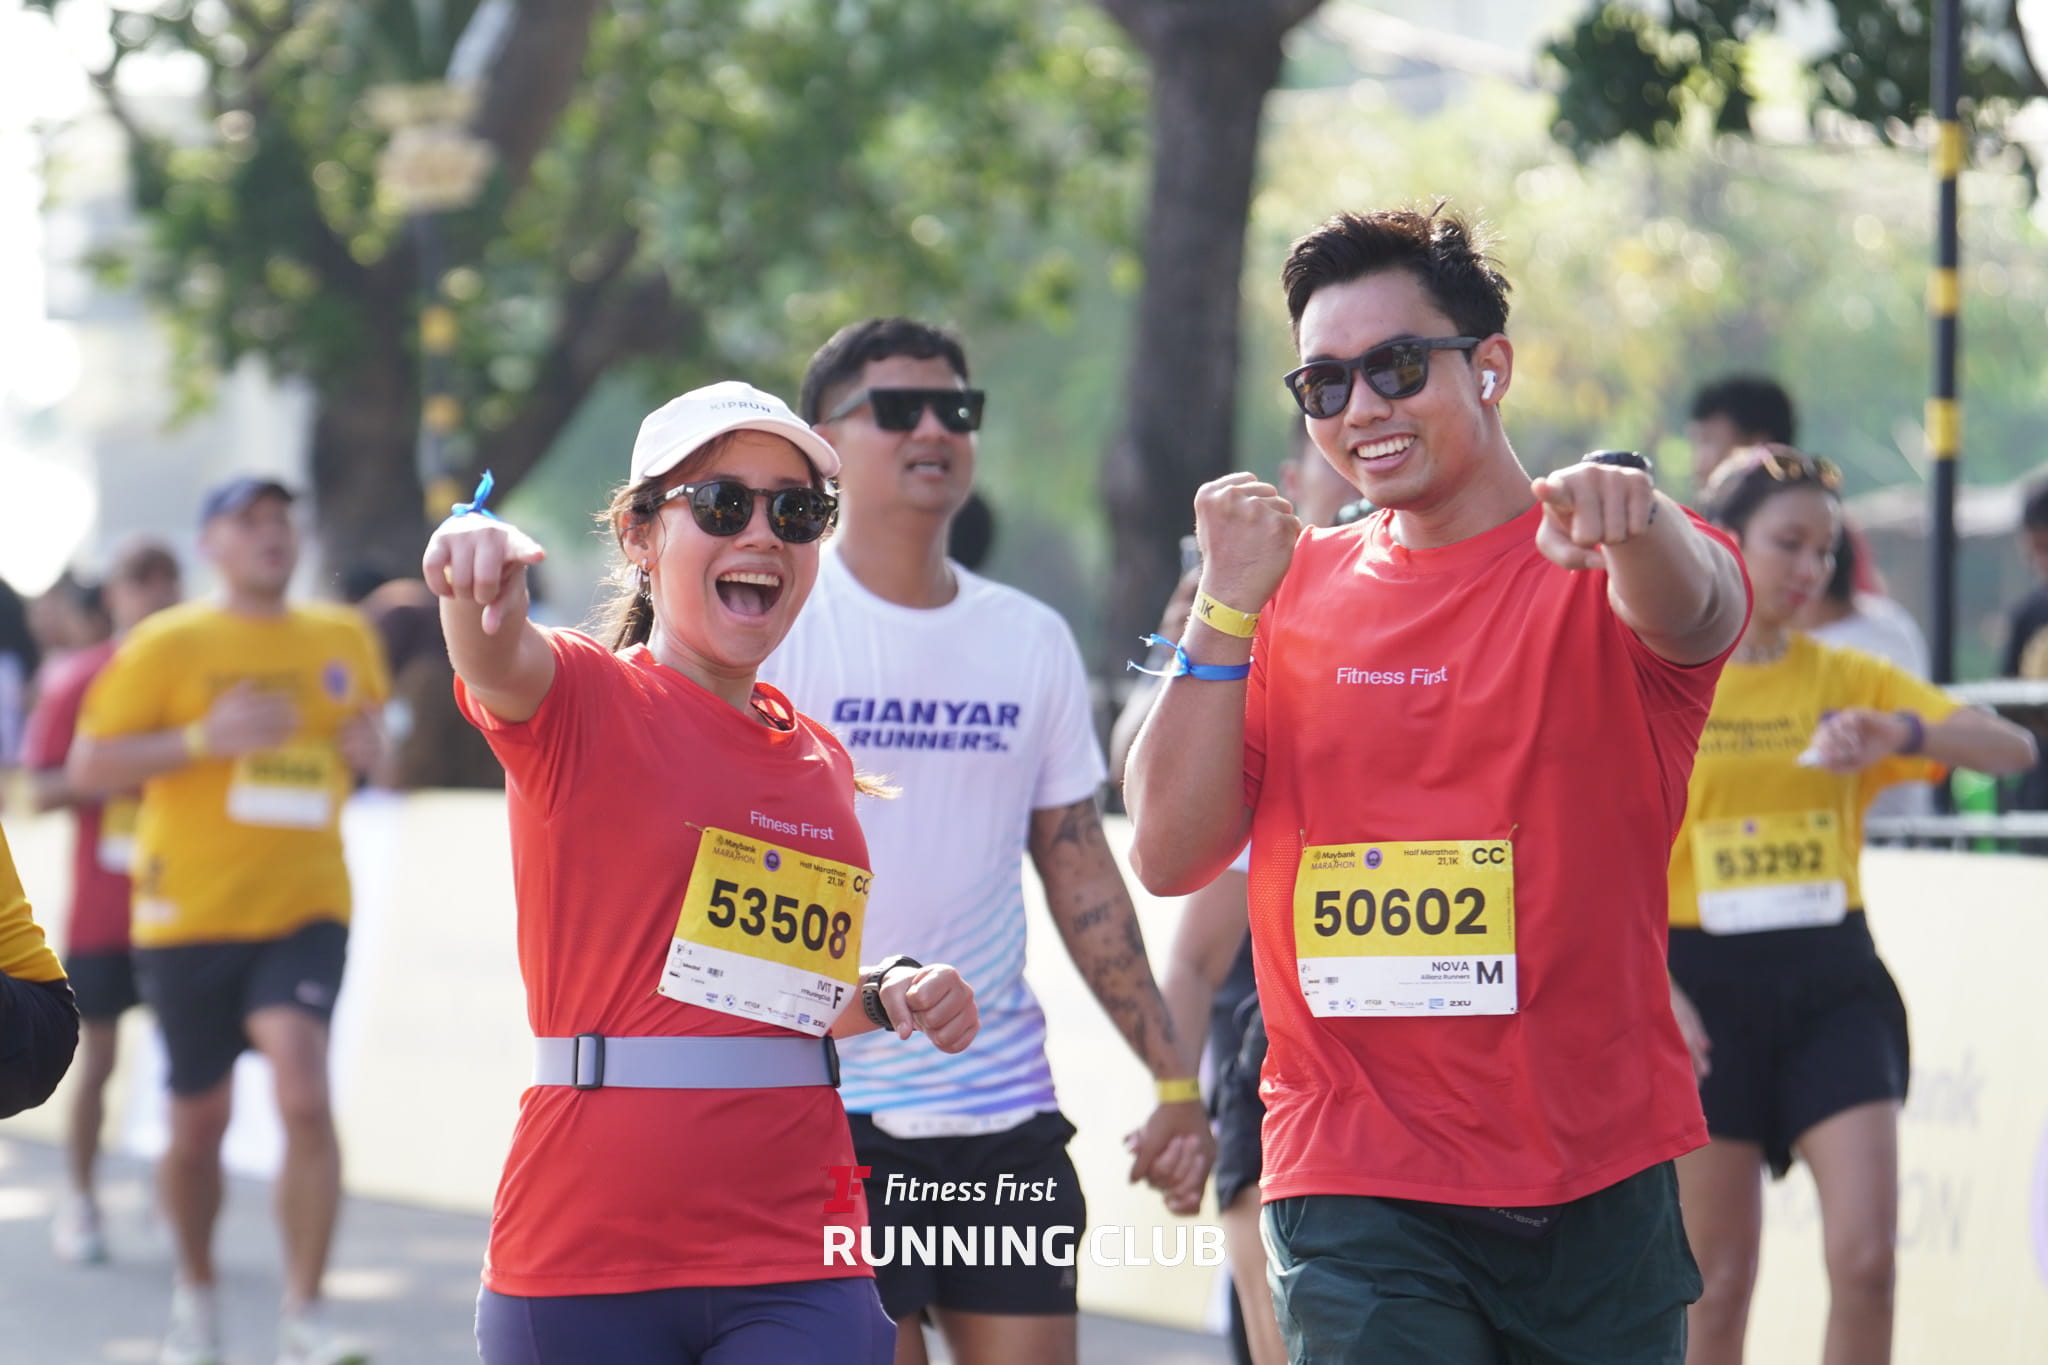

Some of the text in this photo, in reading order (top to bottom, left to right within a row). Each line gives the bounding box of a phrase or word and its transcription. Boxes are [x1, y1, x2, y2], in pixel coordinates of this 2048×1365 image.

[709, 401, 771, 413] KIPRUN
[1336, 666, 1448, 686] Fitness First
[832, 697, 1020, 728] GIANYAR
[849, 729, 1008, 751] RUNNERS.
[750, 810, 834, 841] Fitness First
[725, 838, 756, 853] Maybank
[1321, 850, 1356, 860] Maybank
[1403, 848, 1459, 857] Half Marathon
[712, 846, 756, 865] MARATHON
[1311, 860, 1356, 870] MARATHON
[1471, 847, 1505, 865] CC
[1714, 840, 1824, 882] 53292
[800, 861, 847, 878] Half Marathon
[707, 878, 852, 960] 53508
[1313, 887, 1487, 937] 50602
[1431, 961, 1470, 973] NOVA
[1476, 960, 1504, 985] M
[1443, 973, 1471, 981] Runners
[832, 986, 844, 1009] F
